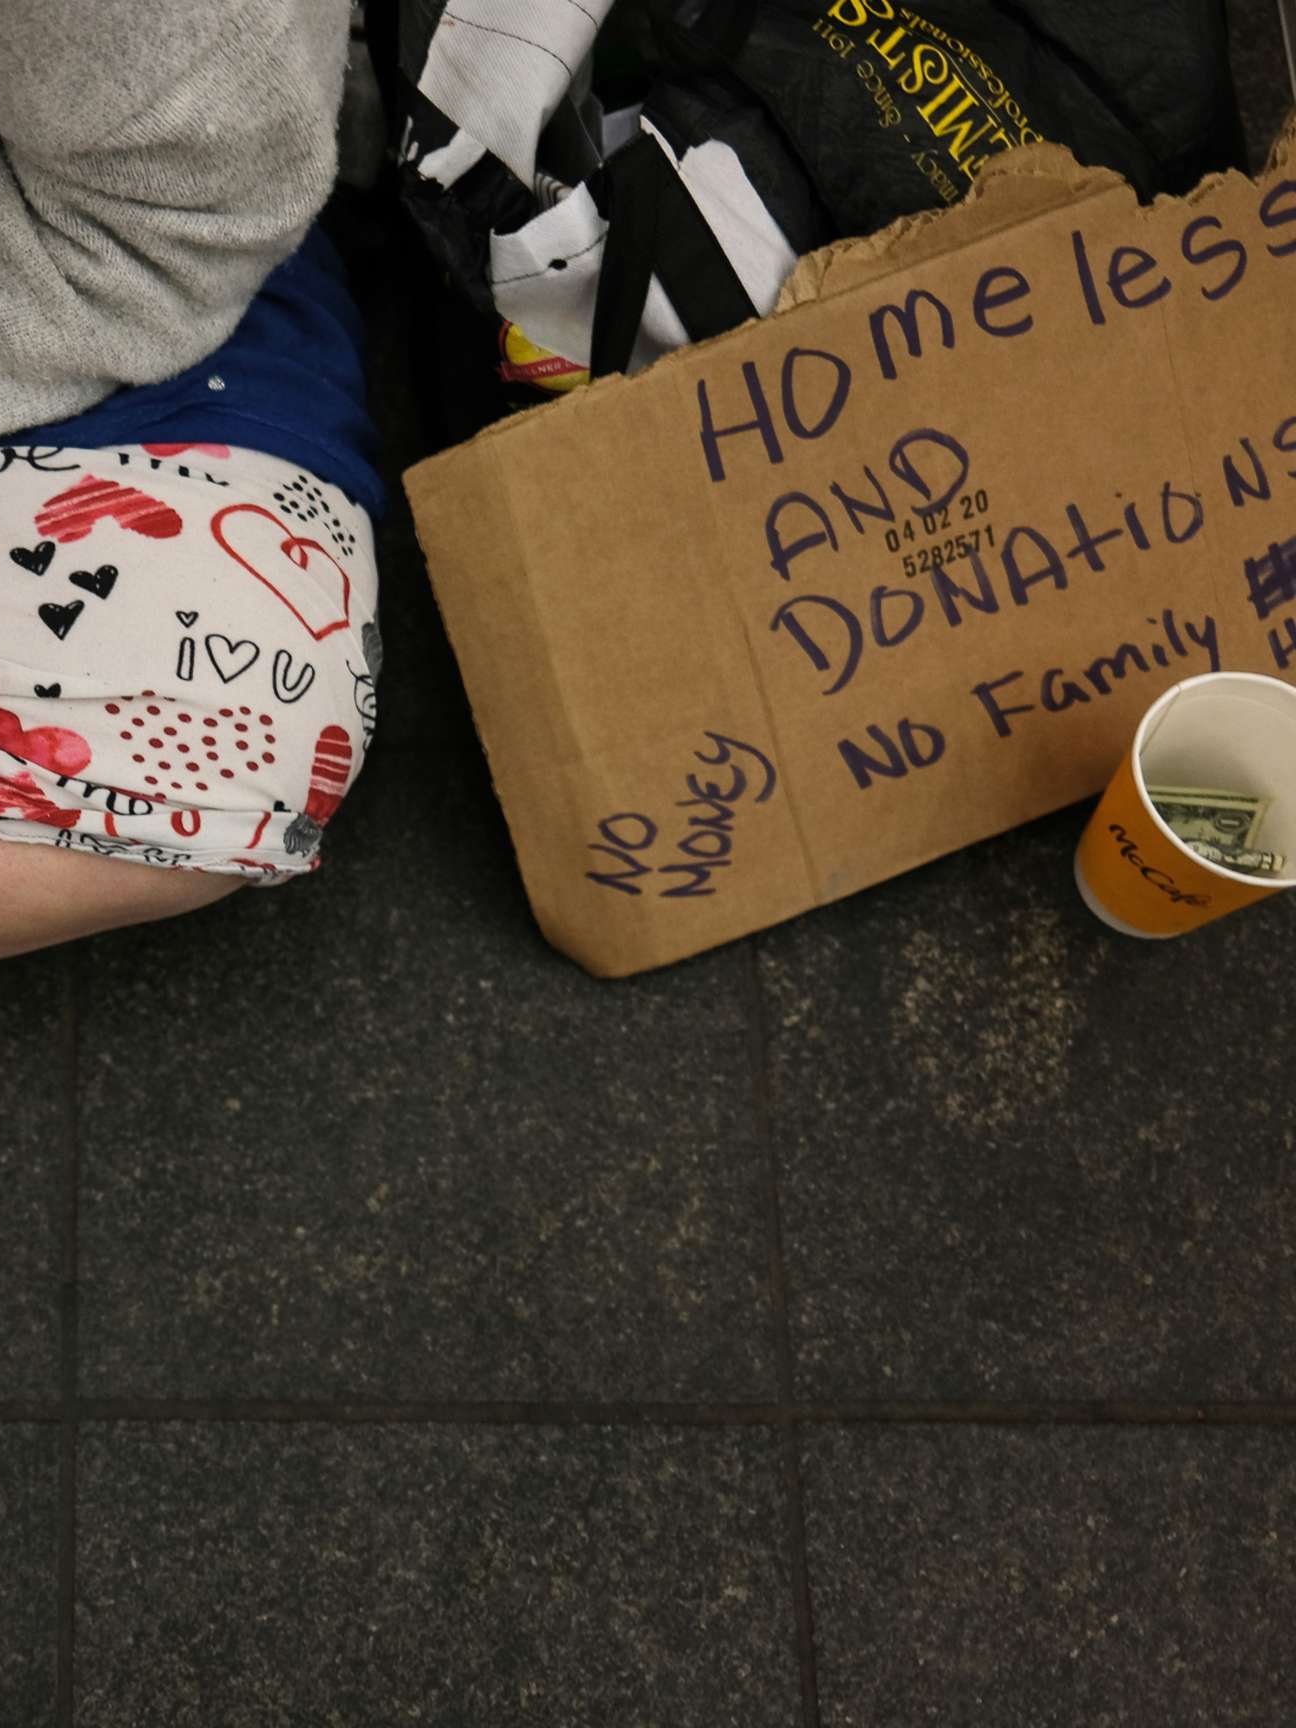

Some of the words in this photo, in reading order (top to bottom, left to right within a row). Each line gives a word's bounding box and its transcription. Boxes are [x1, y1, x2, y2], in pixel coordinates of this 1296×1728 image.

[812, 18, 855, 60] 1911
[856, 59, 902, 129] Since
[765, 427, 970, 581] AND
[885, 520, 916, 553] 04
[923, 506, 952, 536] 02
[959, 489, 989, 520] 20
[902, 524, 995, 578] 5282571
[837, 717, 946, 790] NO
[970, 608, 1221, 738] Family
[584, 812, 658, 896] NO
